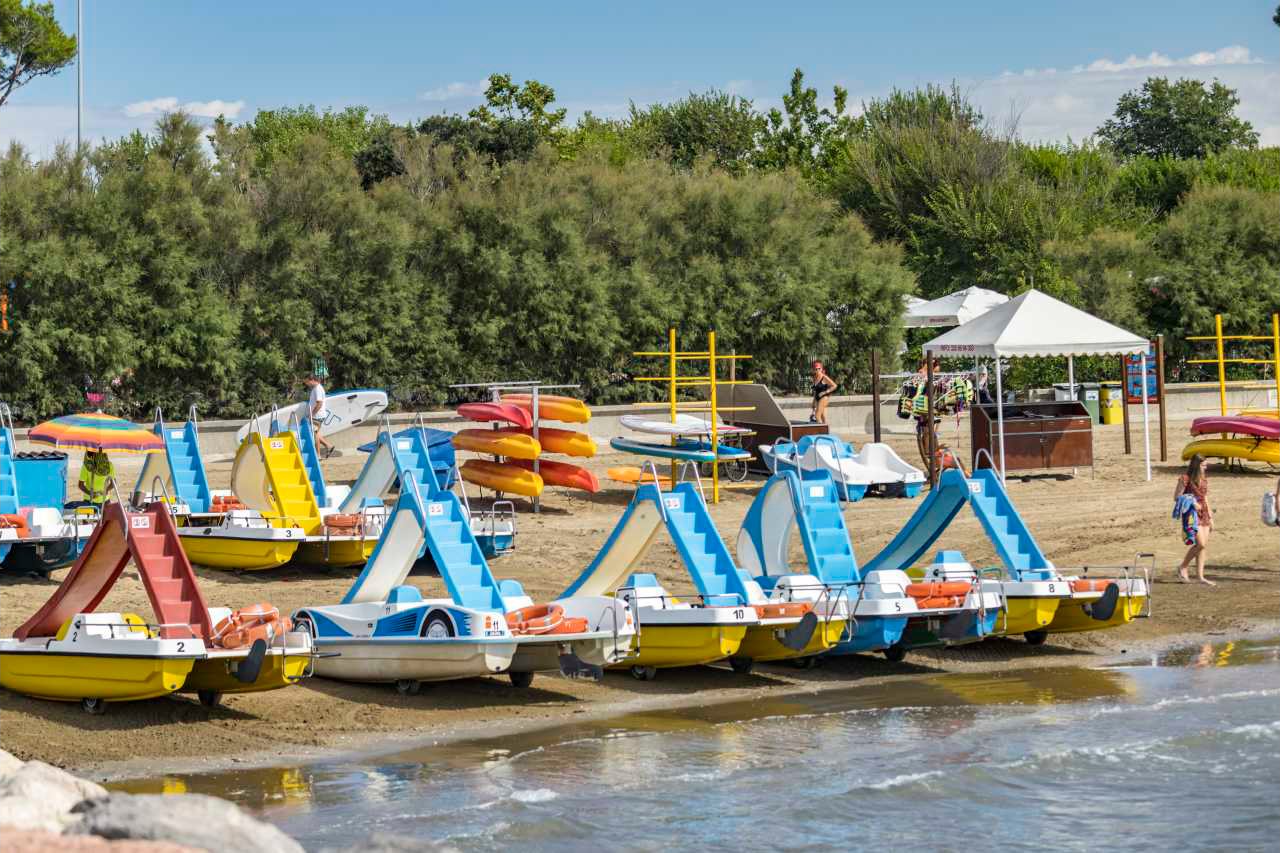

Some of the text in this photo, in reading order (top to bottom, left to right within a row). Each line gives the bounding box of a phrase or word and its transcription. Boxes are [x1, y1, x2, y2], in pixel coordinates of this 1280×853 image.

[286, 529, 292, 538] 3
[1048, 583, 1055, 593] 8
[895, 602, 901, 612] 5
[733, 609, 744, 620] 10
[72, 631, 78, 642] 2
[176, 641, 185, 653] 2
